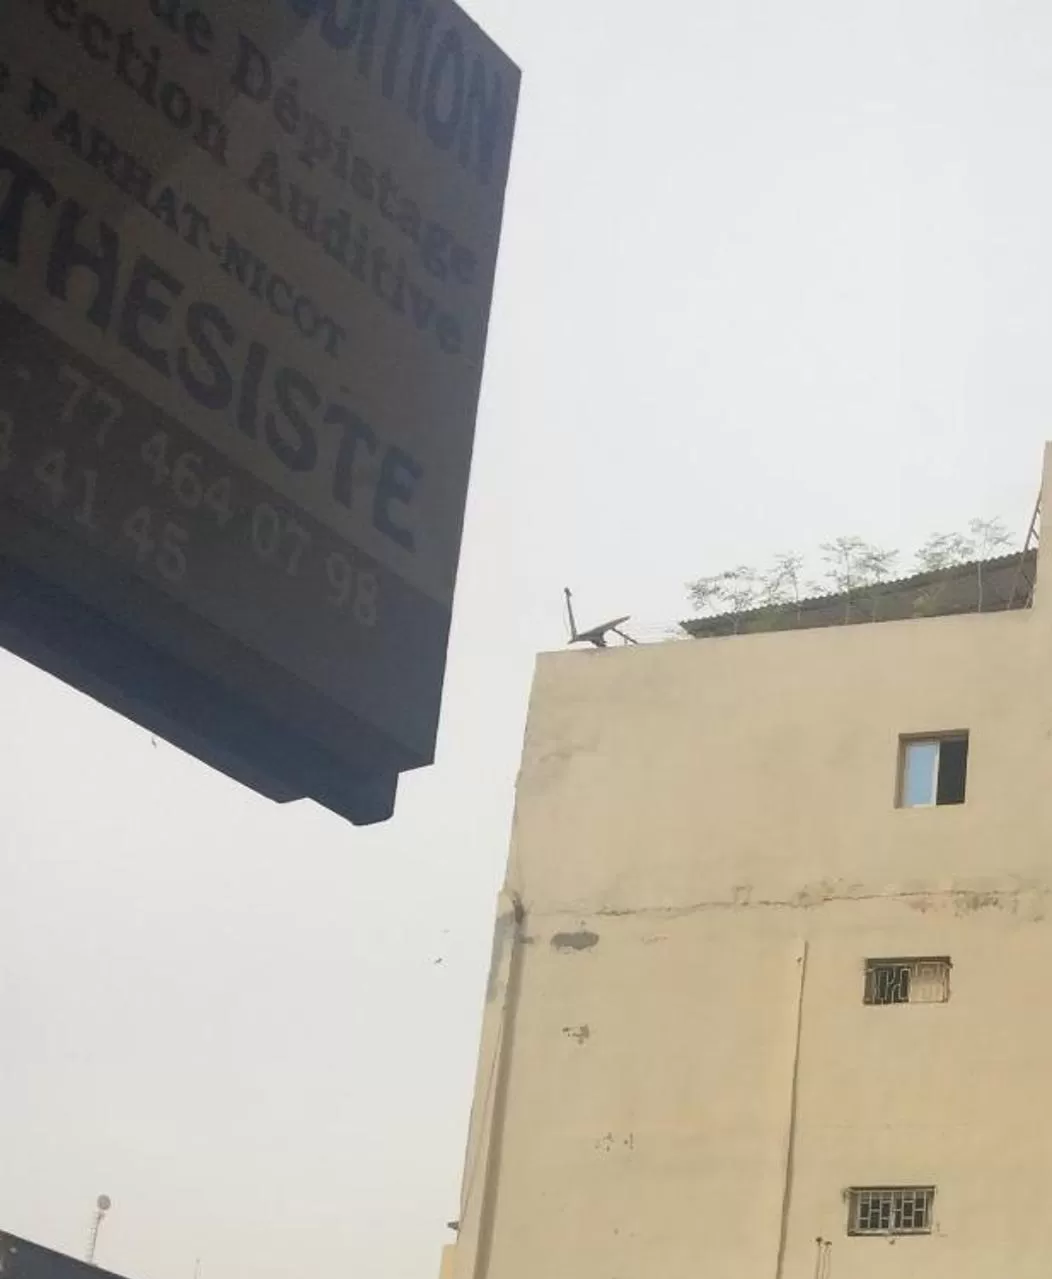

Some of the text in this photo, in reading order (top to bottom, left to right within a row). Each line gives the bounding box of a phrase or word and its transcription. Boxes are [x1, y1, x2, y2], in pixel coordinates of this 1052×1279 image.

[231, 27, 479, 284] Dépistage
[248, 150, 464, 354] Auditive
[34, 448, 190, 580] 41 45
[60, 364, 122, 447] 77
[142, 431, 231, 530] 464
[251, 503, 312, 577] 07
[325, 551, 380, 627] 98
